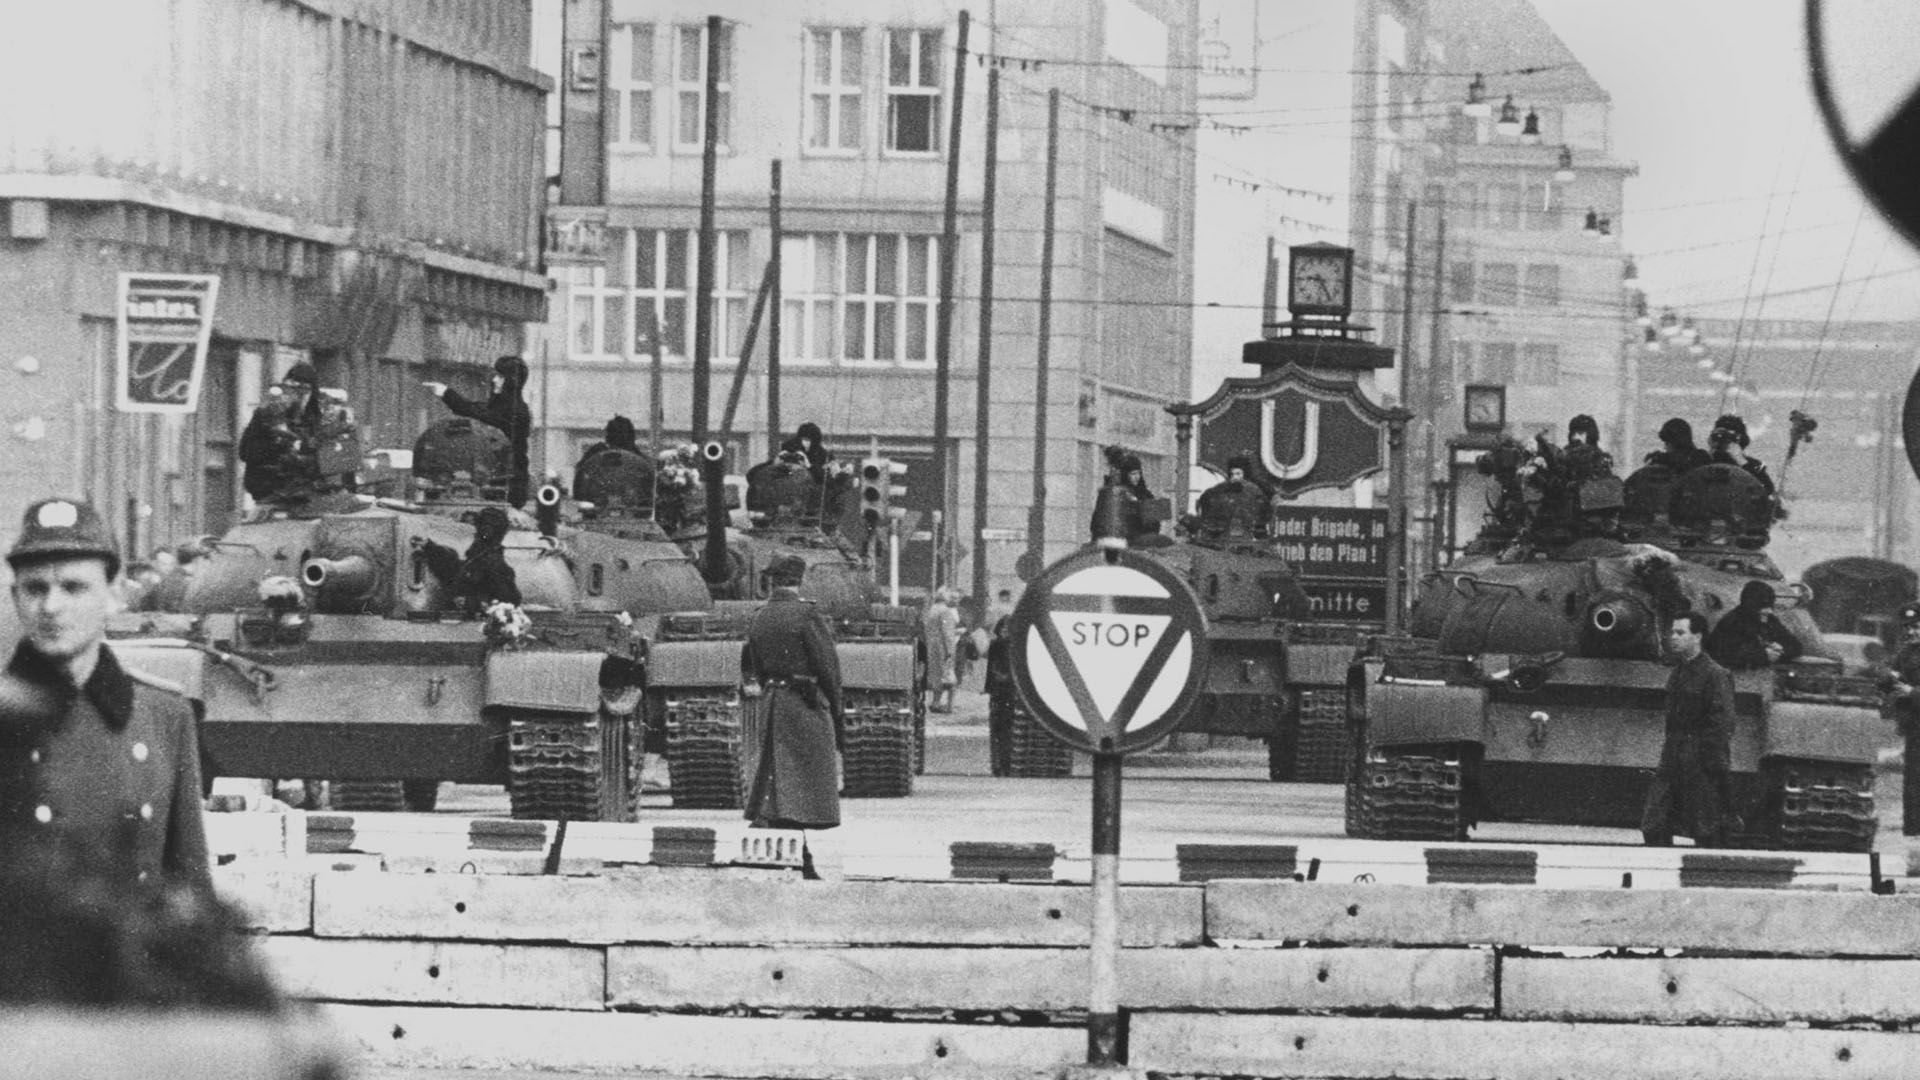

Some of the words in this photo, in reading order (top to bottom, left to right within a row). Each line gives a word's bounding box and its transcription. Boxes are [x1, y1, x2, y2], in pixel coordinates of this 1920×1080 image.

[1261, 400, 1319, 479] U
[1273, 517, 1306, 538] jeder
[1275, 543, 1306, 561] trieb
[1309, 543, 1333, 562] den
[1308, 592, 1370, 612] mitte
[1072, 621, 1150, 644] STOP
